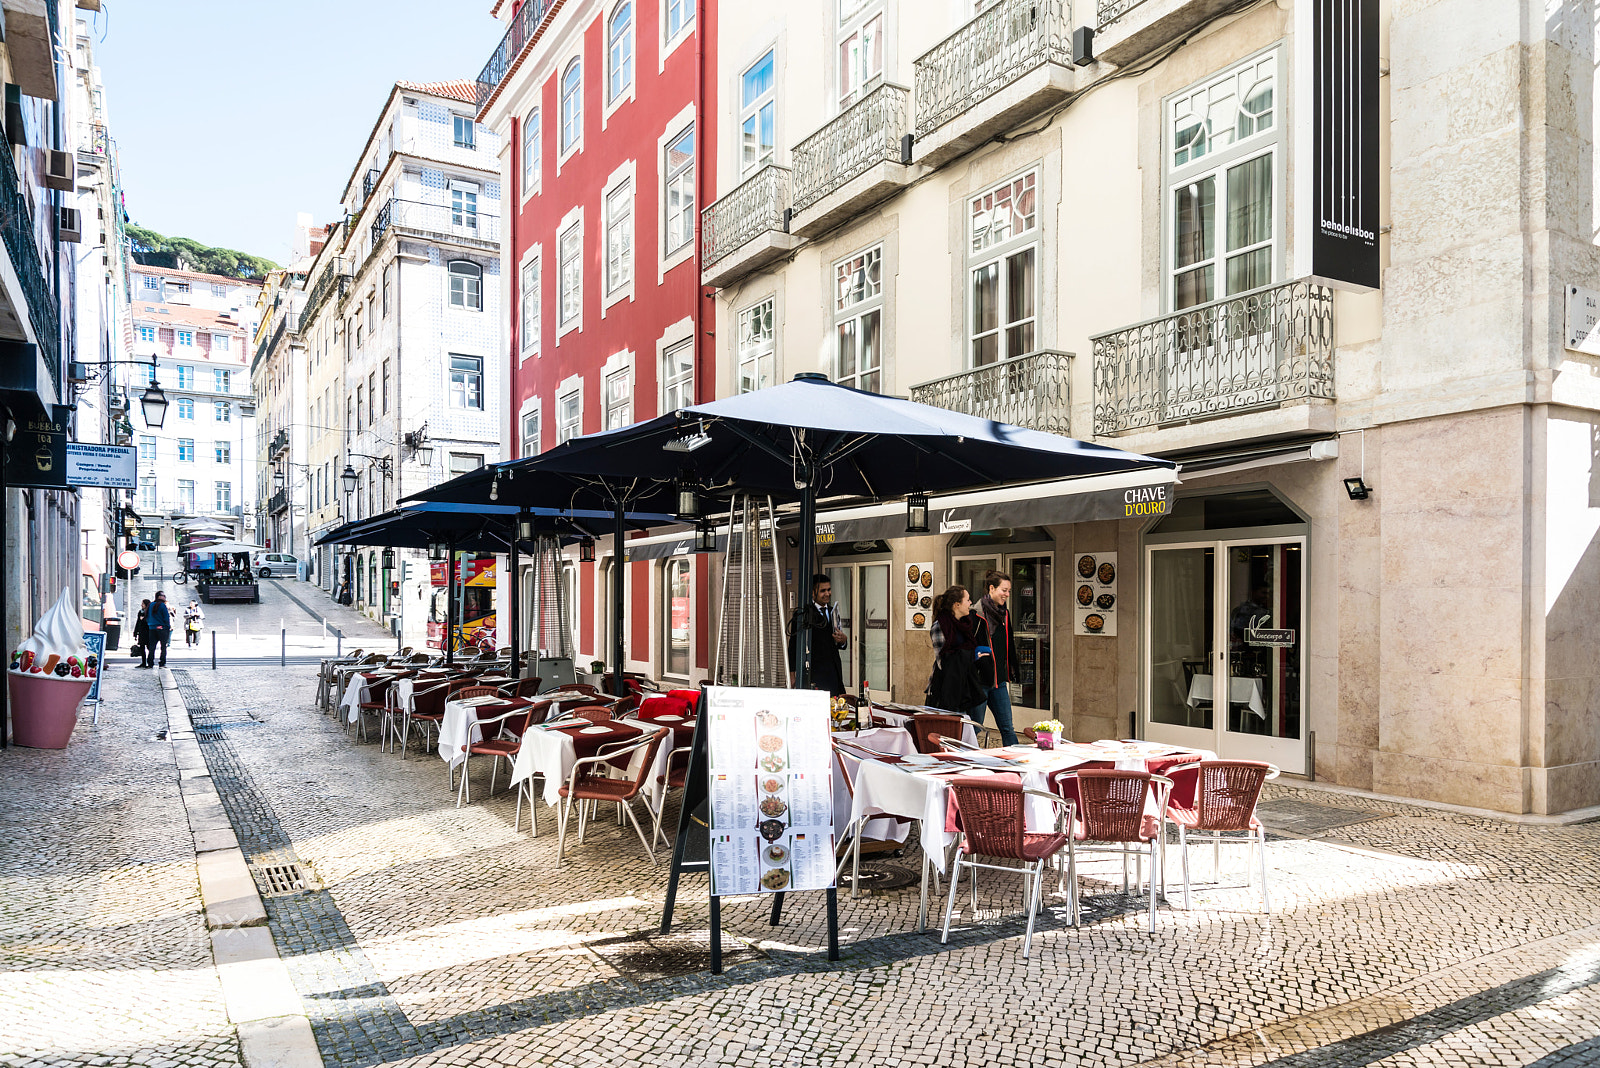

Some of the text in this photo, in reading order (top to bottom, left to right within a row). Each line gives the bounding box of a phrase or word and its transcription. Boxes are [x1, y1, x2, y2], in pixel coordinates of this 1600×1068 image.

[107, 447, 130, 455] PREDIAL
[1124, 486, 1166, 503] CHAVE
[1124, 500, 1166, 517] D'OURO
[815, 523, 835, 535] CHAVE
